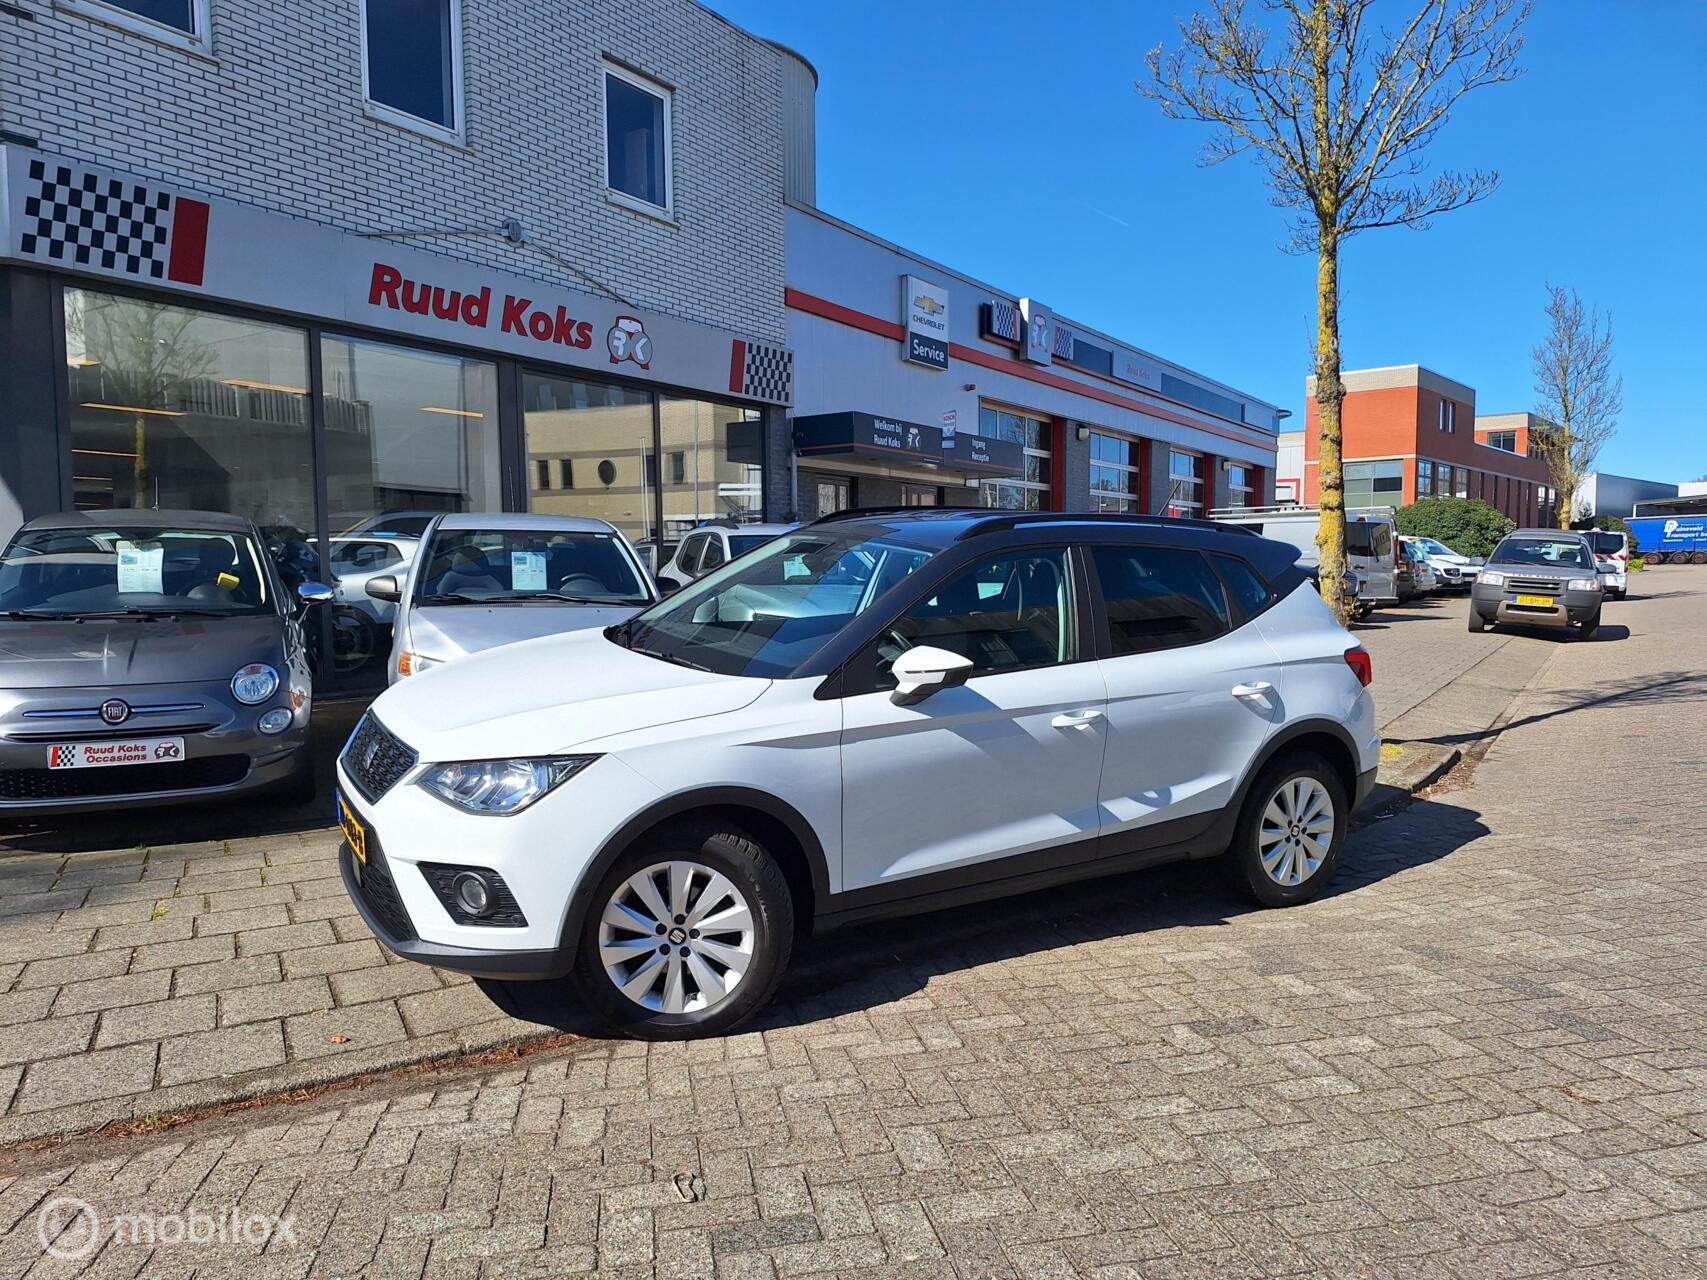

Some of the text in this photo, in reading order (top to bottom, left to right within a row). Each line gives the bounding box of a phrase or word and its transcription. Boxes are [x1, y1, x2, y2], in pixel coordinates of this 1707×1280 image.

[368, 262, 593, 350] Ruud Koks
[912, 314, 945, 331] CHEVROLET
[913, 339, 945, 362] Service
[874, 419, 895, 432] Welkom
[874, 434, 900, 448] Ruud Koks
[107, 706, 122, 717] FIAT
[84, 744, 147, 754] Ruud Koks
[86, 753, 147, 763] Occasions
